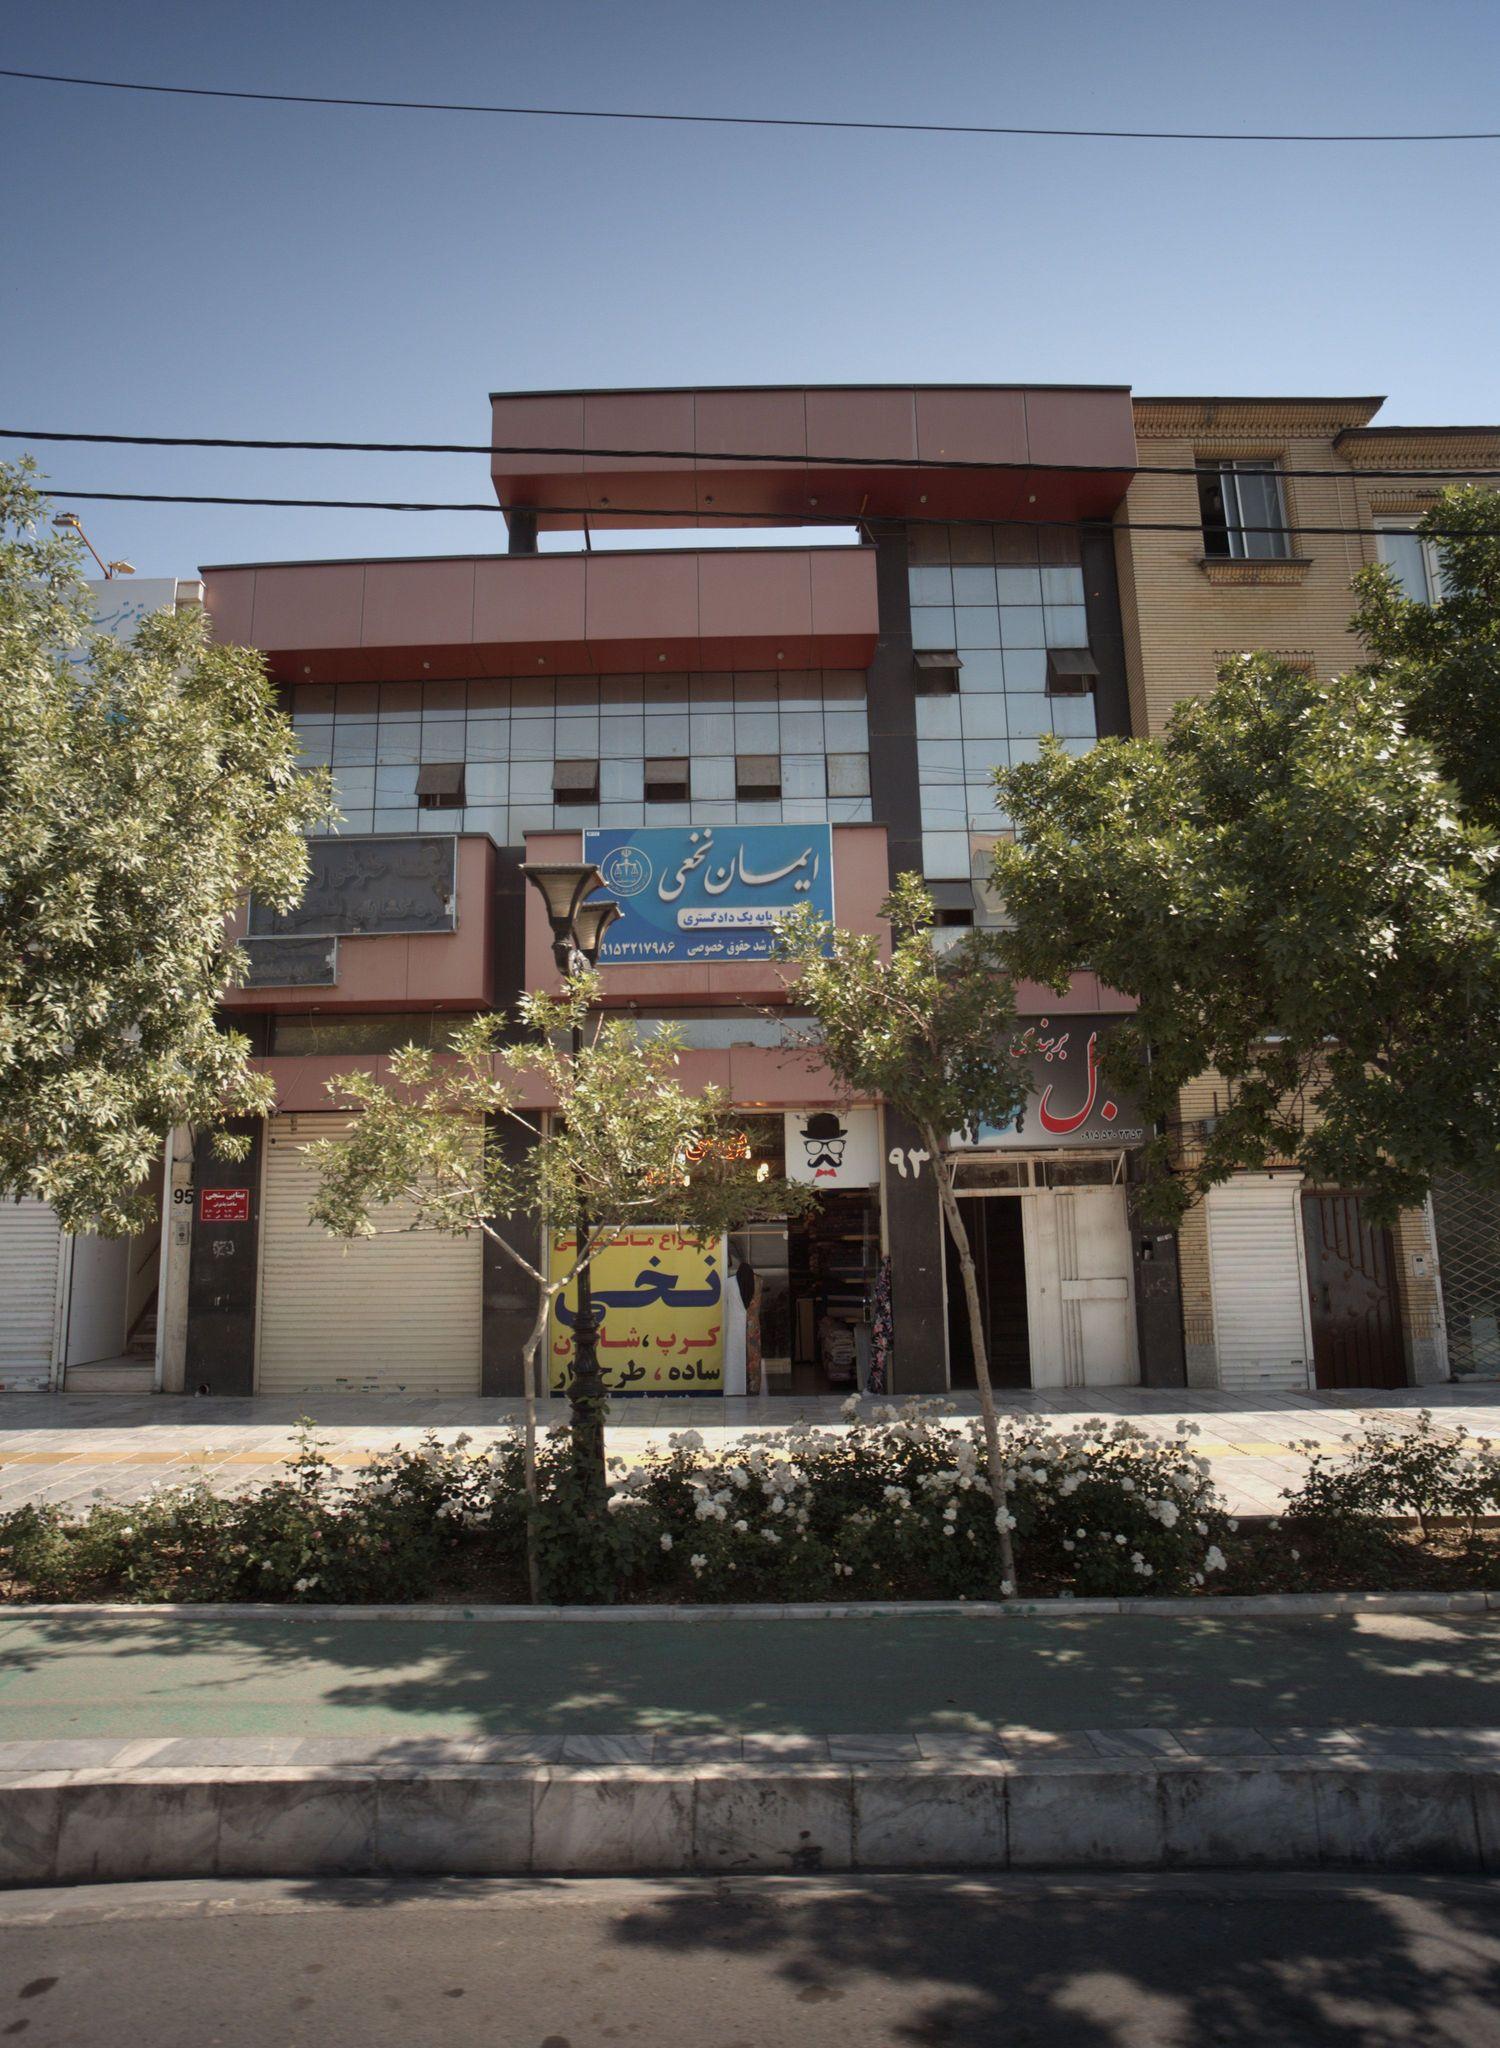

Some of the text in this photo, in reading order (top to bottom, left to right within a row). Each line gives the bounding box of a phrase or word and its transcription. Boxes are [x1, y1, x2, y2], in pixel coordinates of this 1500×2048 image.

[658, 828, 819, 901] ایمان نخعی
[683, 911, 735, 926] دادگستری
[737, 911, 753, 925] یک
[756, 910, 772, 925] پایه
[687, 940, 724, 956] خصوصی
[726, 940, 751, 955] حقوق
[1039, 1031, 1118, 1135] بل
[889, 1147, 930, 1179] ۹۳
[174, 1188, 194, 1205] 95
[205, 1192, 225, 1201] سنجی
[555, 1255, 721, 1328] نخی
[656, 1326, 720, 1356] کرپ
[554, 1359, 646, 1389] طرحار
[668, 1359, 720, 1381] ساده
